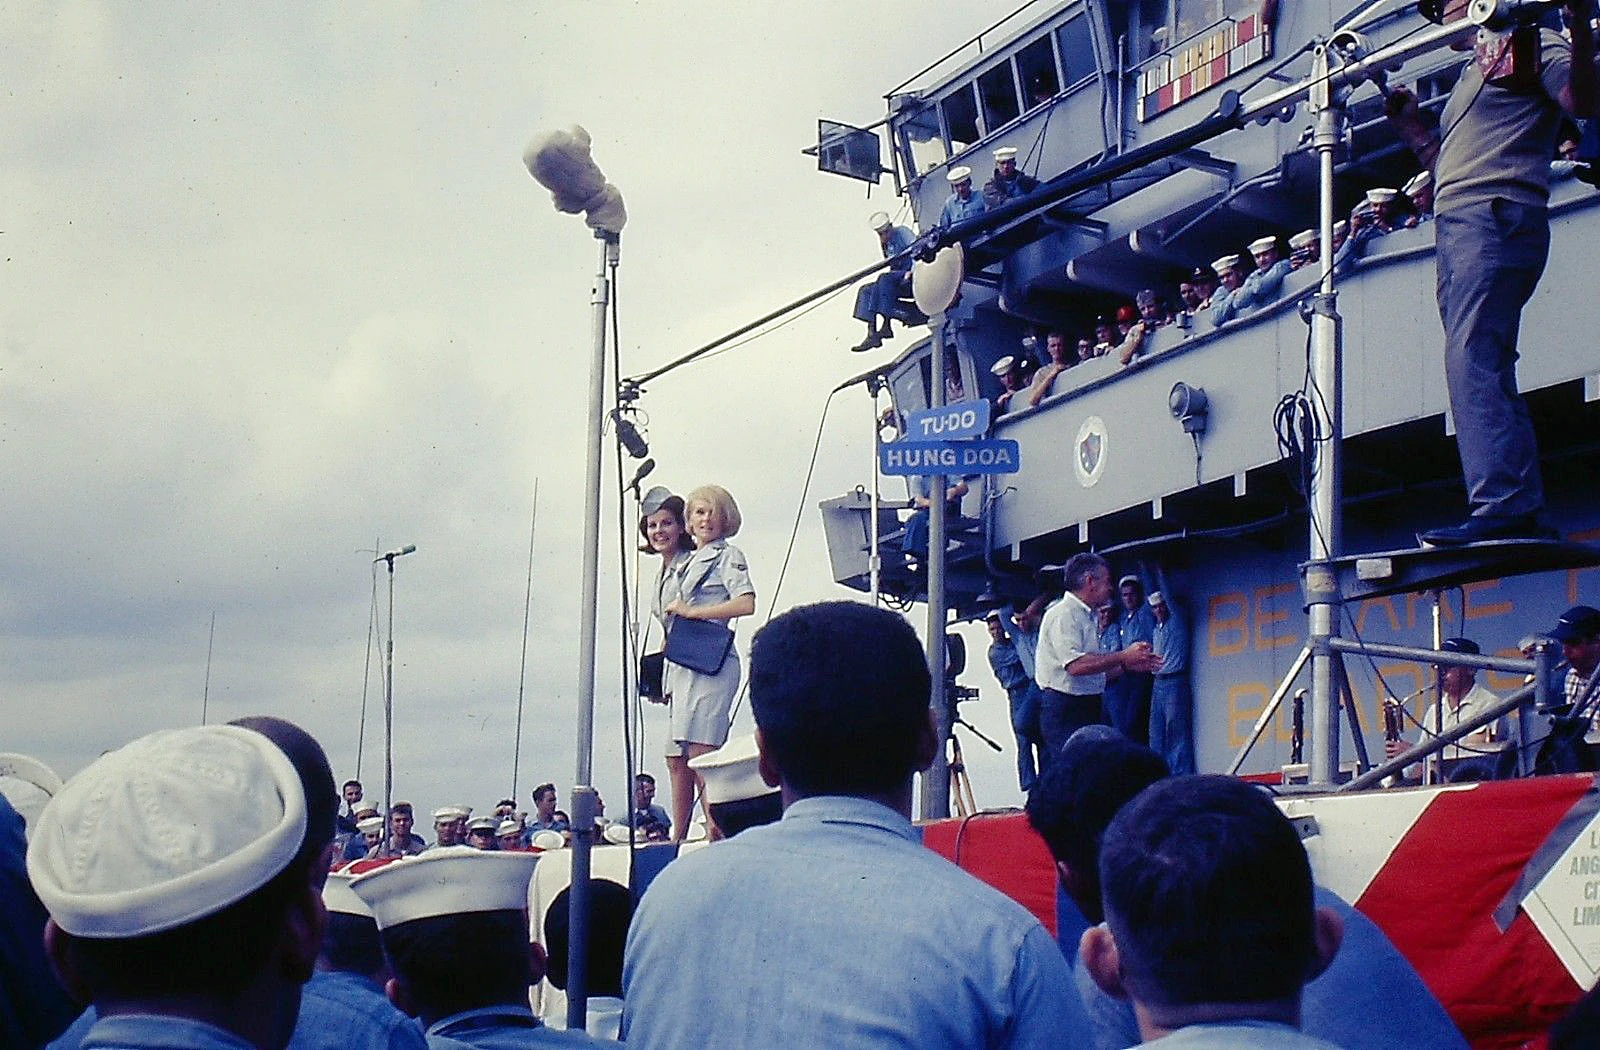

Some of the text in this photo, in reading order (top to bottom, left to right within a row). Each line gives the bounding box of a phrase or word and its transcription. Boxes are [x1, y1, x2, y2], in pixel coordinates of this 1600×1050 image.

[887, 448, 1012, 467] HUNG DOA
[1208, 579, 1514, 657] BEARE
